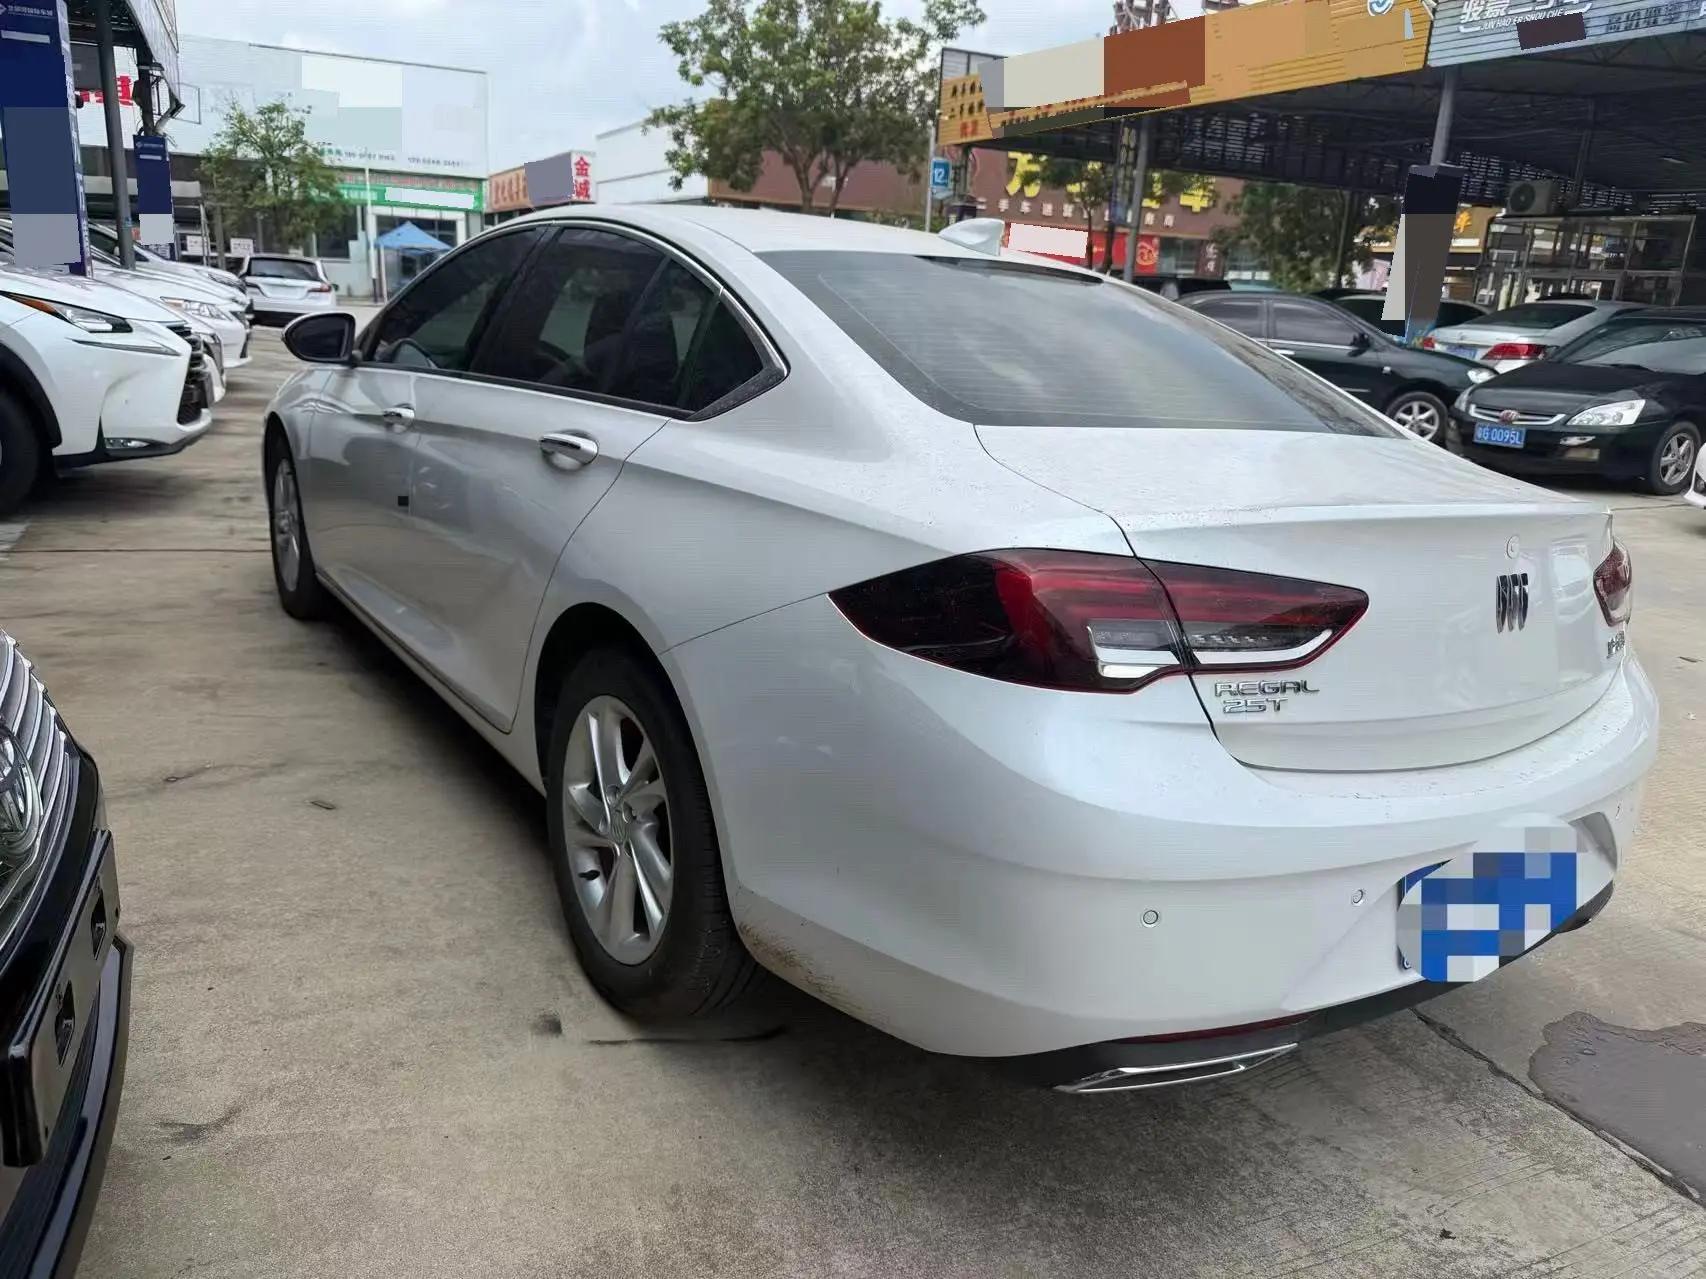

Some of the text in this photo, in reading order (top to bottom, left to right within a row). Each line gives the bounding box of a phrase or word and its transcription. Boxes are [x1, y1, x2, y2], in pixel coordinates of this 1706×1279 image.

[934, 167, 948, 183] 12
[1214, 680, 1320, 697] REGAL
[1223, 697, 1288, 714] 25T
